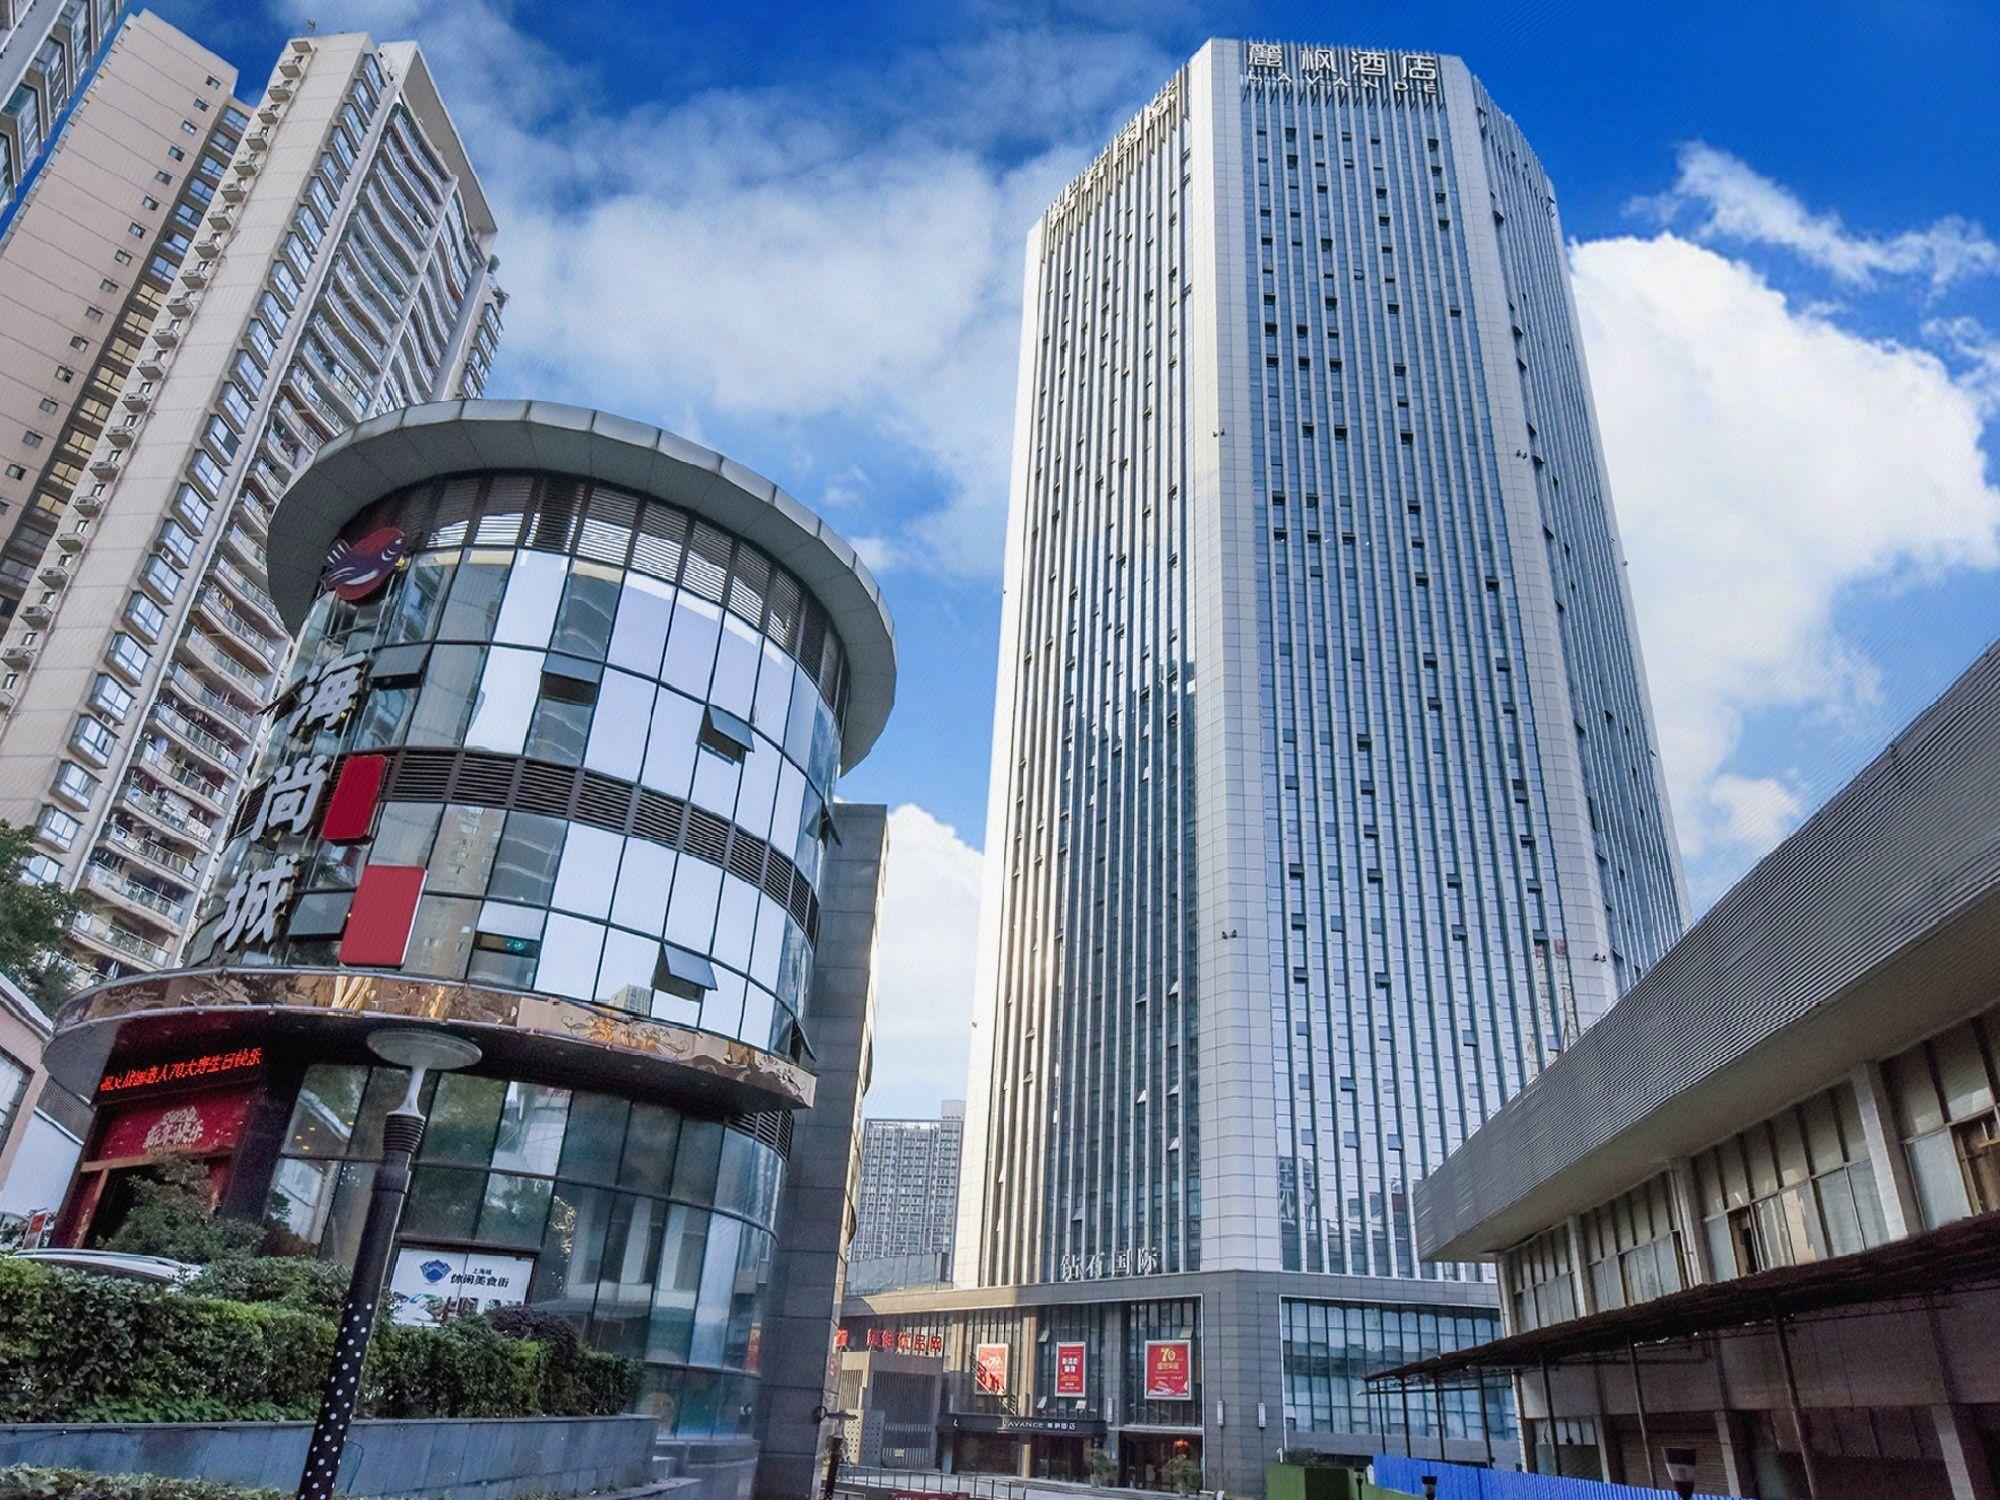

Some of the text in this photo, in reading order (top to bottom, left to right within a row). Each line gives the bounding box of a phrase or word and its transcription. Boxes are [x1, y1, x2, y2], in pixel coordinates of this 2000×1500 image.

[213, 651, 368, 951] 海尚城
[450, 1274, 509, 1288] 休闲美食街
[1160, 1348, 1176, 1361] 70
